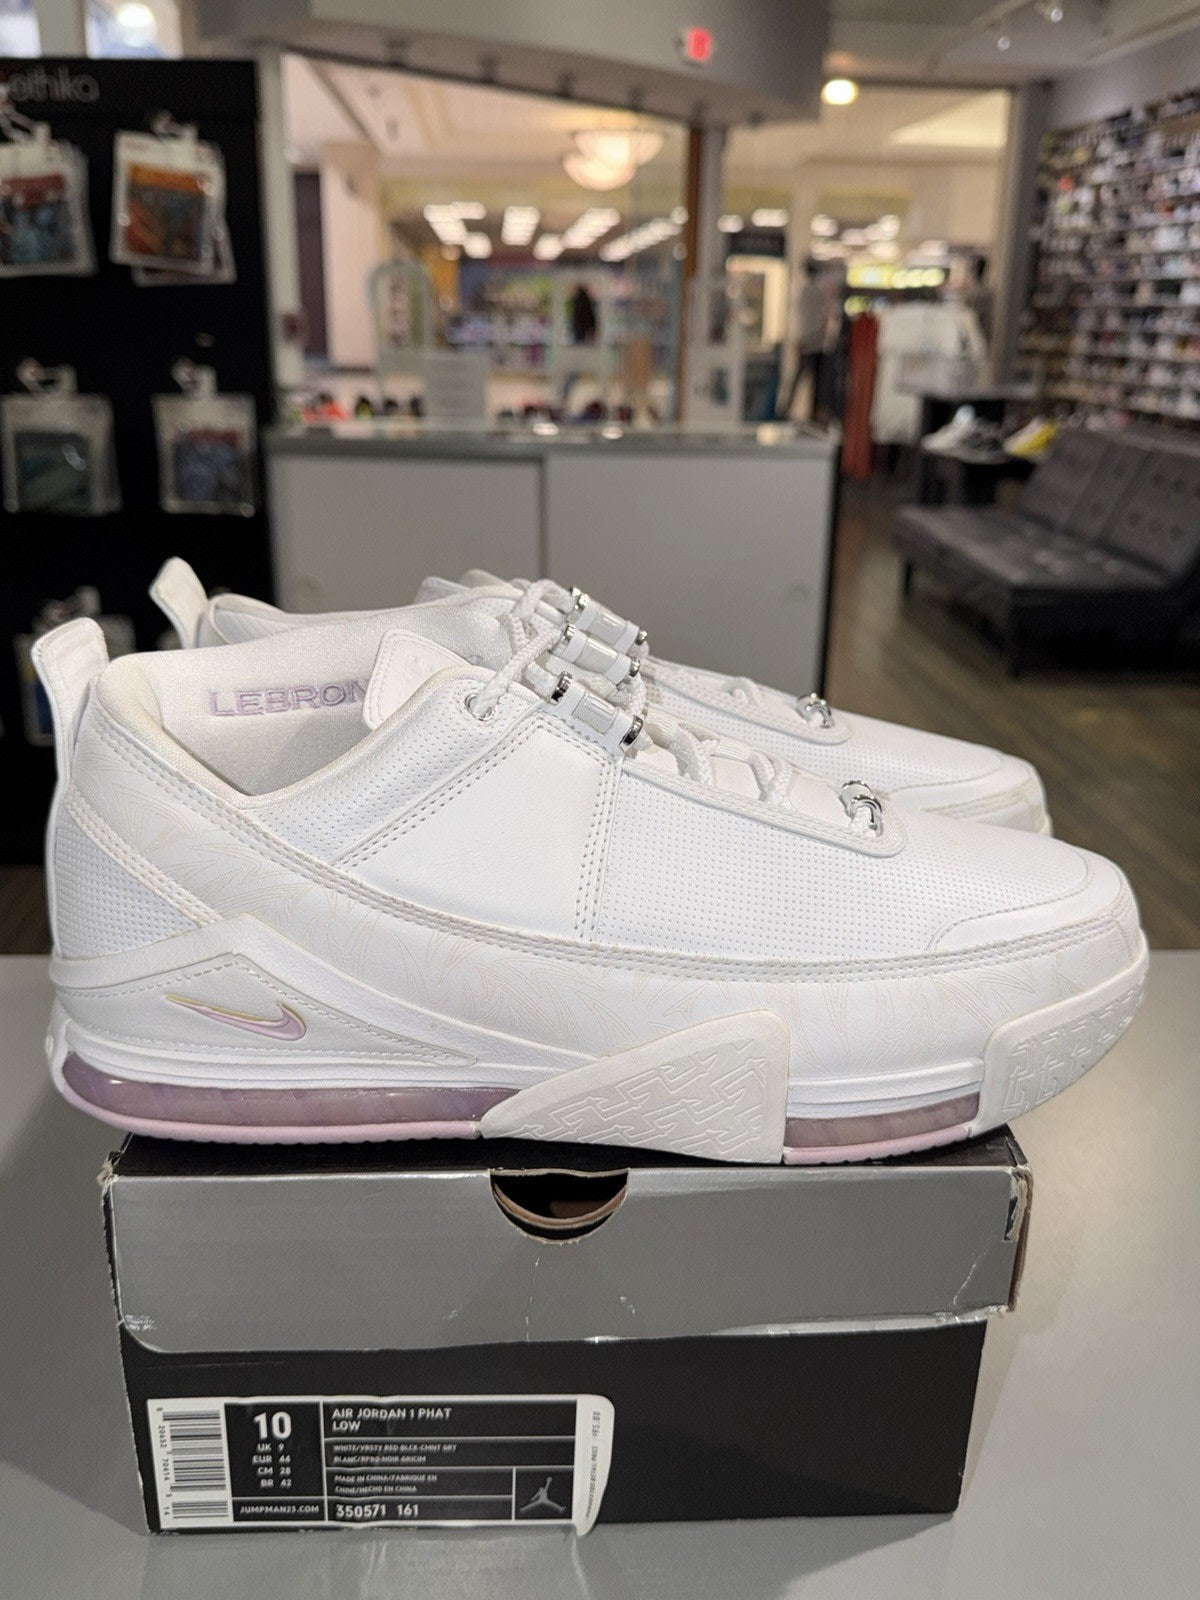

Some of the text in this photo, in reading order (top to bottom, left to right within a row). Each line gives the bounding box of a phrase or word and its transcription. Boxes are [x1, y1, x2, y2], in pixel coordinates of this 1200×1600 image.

[332, 1408, 354, 1419] AIR
[357, 1408, 406, 1420] JORDAN
[418, 1408, 452, 1419] PHAT
[254, 1410, 292, 1440] 10
[332, 1420, 361, 1432] LOW
[257, 1443, 285, 1452] UK 9
[252, 1455, 291, 1464] EUR 44
[257, 1467, 273, 1476] CM
[261, 1479, 292, 1488] BR 42
[334, 1475, 355, 1483] MADE
[335, 1503, 419, 1518] 350571 161
